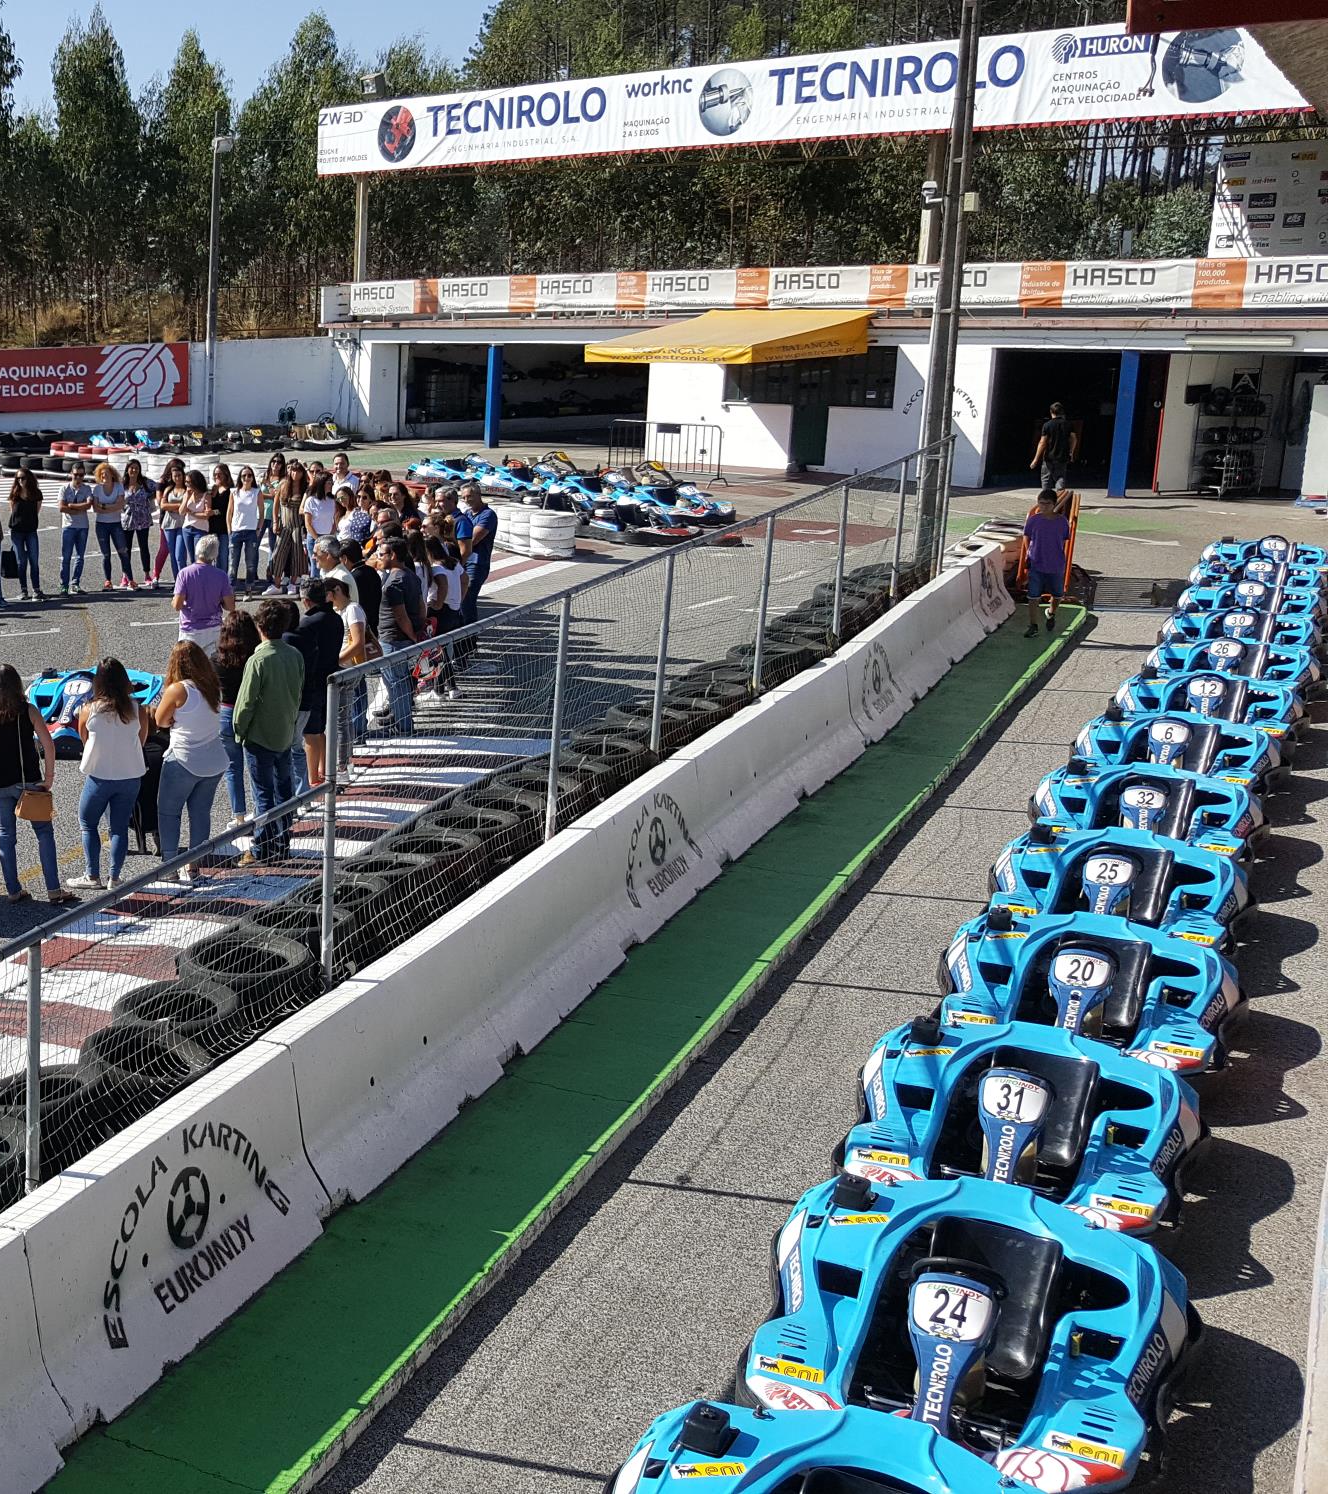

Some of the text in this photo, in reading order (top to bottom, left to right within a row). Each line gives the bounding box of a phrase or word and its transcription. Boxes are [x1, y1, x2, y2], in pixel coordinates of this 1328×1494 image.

[1085, 35, 1146, 56] HURON
[1053, 71, 1098, 82] CENTROS
[625, 75, 694, 99] worknc
[1052, 80, 1121, 94] MAQUINAÇÃO
[1050, 92, 1142, 106] ALTA VELOCIDADE
[426, 86, 607, 138] TECNIROLO
[796, 111, 870, 125] ENGENHARIA
[623, 116, 671, 128] MAQUINAÇÃO
[622, 130, 627, 138] 2
[639, 129, 660, 137] EIXOS
[346, 154, 368, 162] MOLDES
[652, 276, 710, 292] HASCO
[774, 273, 841, 290] HASCO
[915, 270, 988, 289] HACO
[1073, 267, 1157, 287] HASCO
[1196, 278, 1232, 286] produtos.
[354, 286, 395, 301] HASCO
[442, 283, 488, 298] HASCO
[540, 279, 593, 295] HASCO
[1070, 293, 1186, 305] Enabling with System.
[1252, 291, 1305, 304] Enabling
[902, 386, 924, 415] ESCO
[1254, 563, 1266, 571] 22
[1247, 585, 1255, 594] 8
[1231, 616, 1246, 625] 30
[1215, 643, 1230, 655] 26
[1200, 683, 1218, 695] 12
[1164, 726, 1174, 740] 6
[1137, 791, 1155, 806] 32
[626, 792, 704, 909] ESCOLA KARTING
[646, 854, 690, 898] EUROINDY
[1097, 862, 1118, 880] 25
[1187, 934, 1214, 944] eni
[1066, 958, 1096, 982] 20
[969, 1015, 996, 1025] eni
[1171, 1047, 1202, 1059] eni
[996, 1083, 1025, 1115] 31
[877, 1154, 906, 1166] eni
[1152, 1128, 1183, 1177] ECNIROLO
[1118, 1203, 1150, 1216] eni
[855, 1214, 888, 1224] eni
[103, 1121, 291, 1350] ESCOLA KARTING
[153, 1214, 255, 1315] EUROINDY
[929, 1288, 969, 1328] 24
[783, 1365, 820, 1383] eni
[922, 1343, 953, 1423] TECNIROLO
[1078, 1445, 1119, 1465] eni
[704, 1462, 745, 1477] eni
